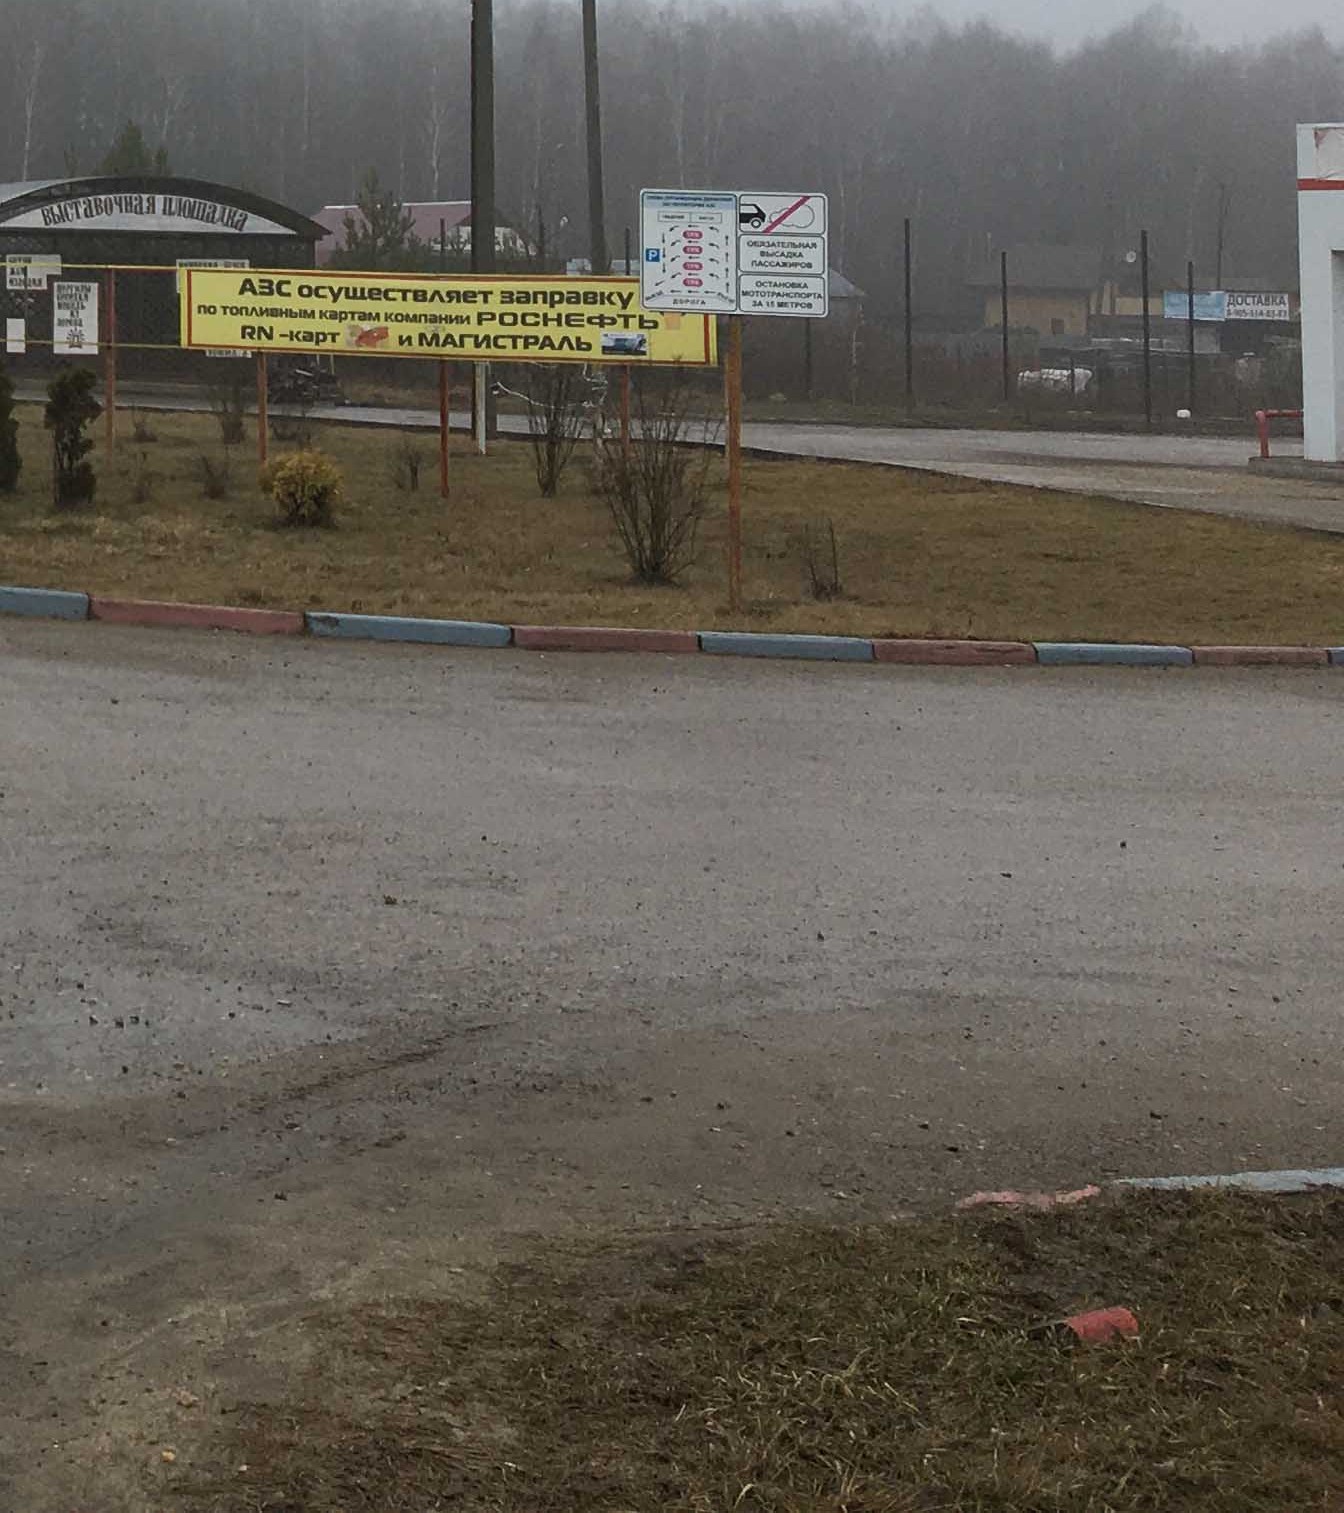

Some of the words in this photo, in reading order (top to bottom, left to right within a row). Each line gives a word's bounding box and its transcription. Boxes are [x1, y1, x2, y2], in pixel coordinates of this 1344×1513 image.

[746, 240, 817, 249] ОБЯЗАТЕЛЬНАЯ
[751, 260, 813, 269] ПАССАЖИРОВ
[755, 281, 808, 289] ОСТАНОВКА
[238, 277, 292, 298] АЗС
[297, 284, 493, 304] осуществляет
[500, 289, 634, 310] заправку
[741, 290, 822, 299] МОТОТРАНСПОРТА
[777, 301, 813, 309] МЕТРОВ
[1227, 294, 1287, 307] ДОСТАВКА
[197, 304, 217, 316] по
[220, 305, 316, 320] топливным
[319, 309, 381, 323] картам
[384, 311, 471, 325] компании
[477, 311, 659, 330] РОСНЕФТЬ
[240, 324, 274, 341] RN
[398, 334, 413, 346] и
[418, 332, 593, 352] МАГИСТРАЛЬ
